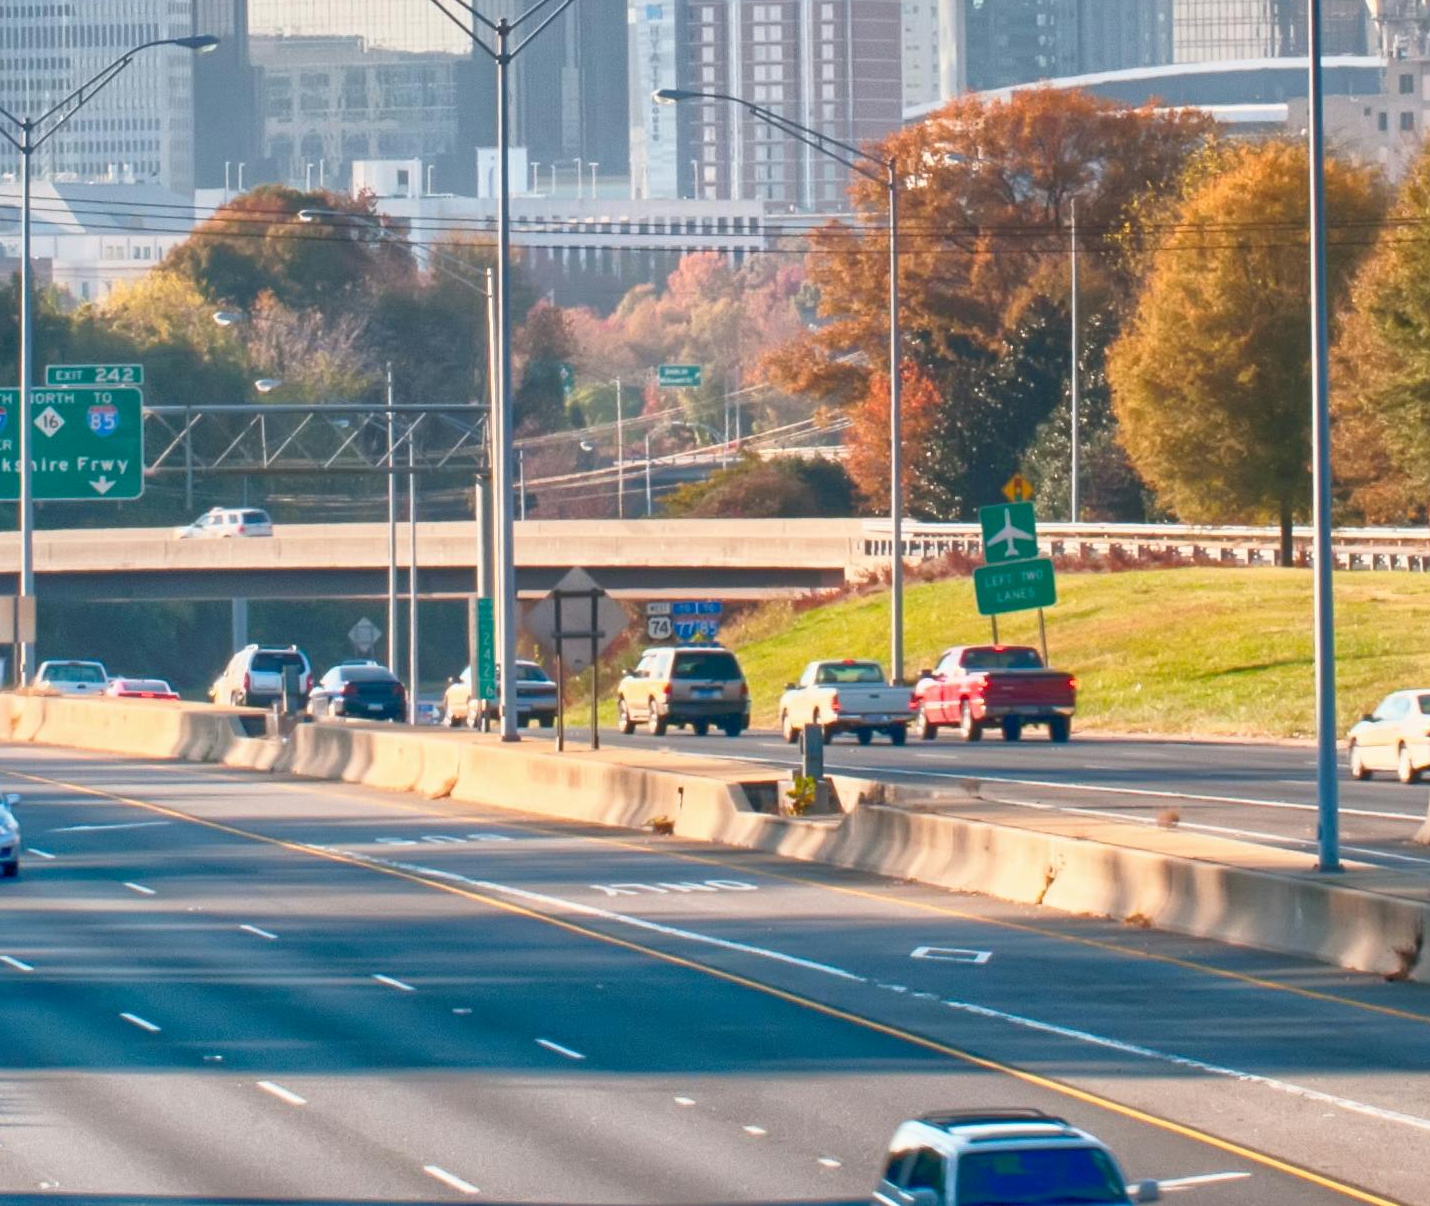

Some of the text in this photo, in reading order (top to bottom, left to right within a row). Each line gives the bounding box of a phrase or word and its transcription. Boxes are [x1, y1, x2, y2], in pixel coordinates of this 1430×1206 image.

[55, 368, 134, 382] EXIT 242
[93, 392, 113, 403] TO
[42, 414, 59, 429] 16
[90, 413, 117, 430] 85
[77, 456, 129, 475] Frwy
[984, 570, 1044, 588] LEFT TWO
[996, 587, 1036, 603] LANES
[651, 620, 668, 635] 74
[675, 621, 695, 635] 77
[700, 621, 717, 635] 85
[589, 879, 759, 897] ONLY
